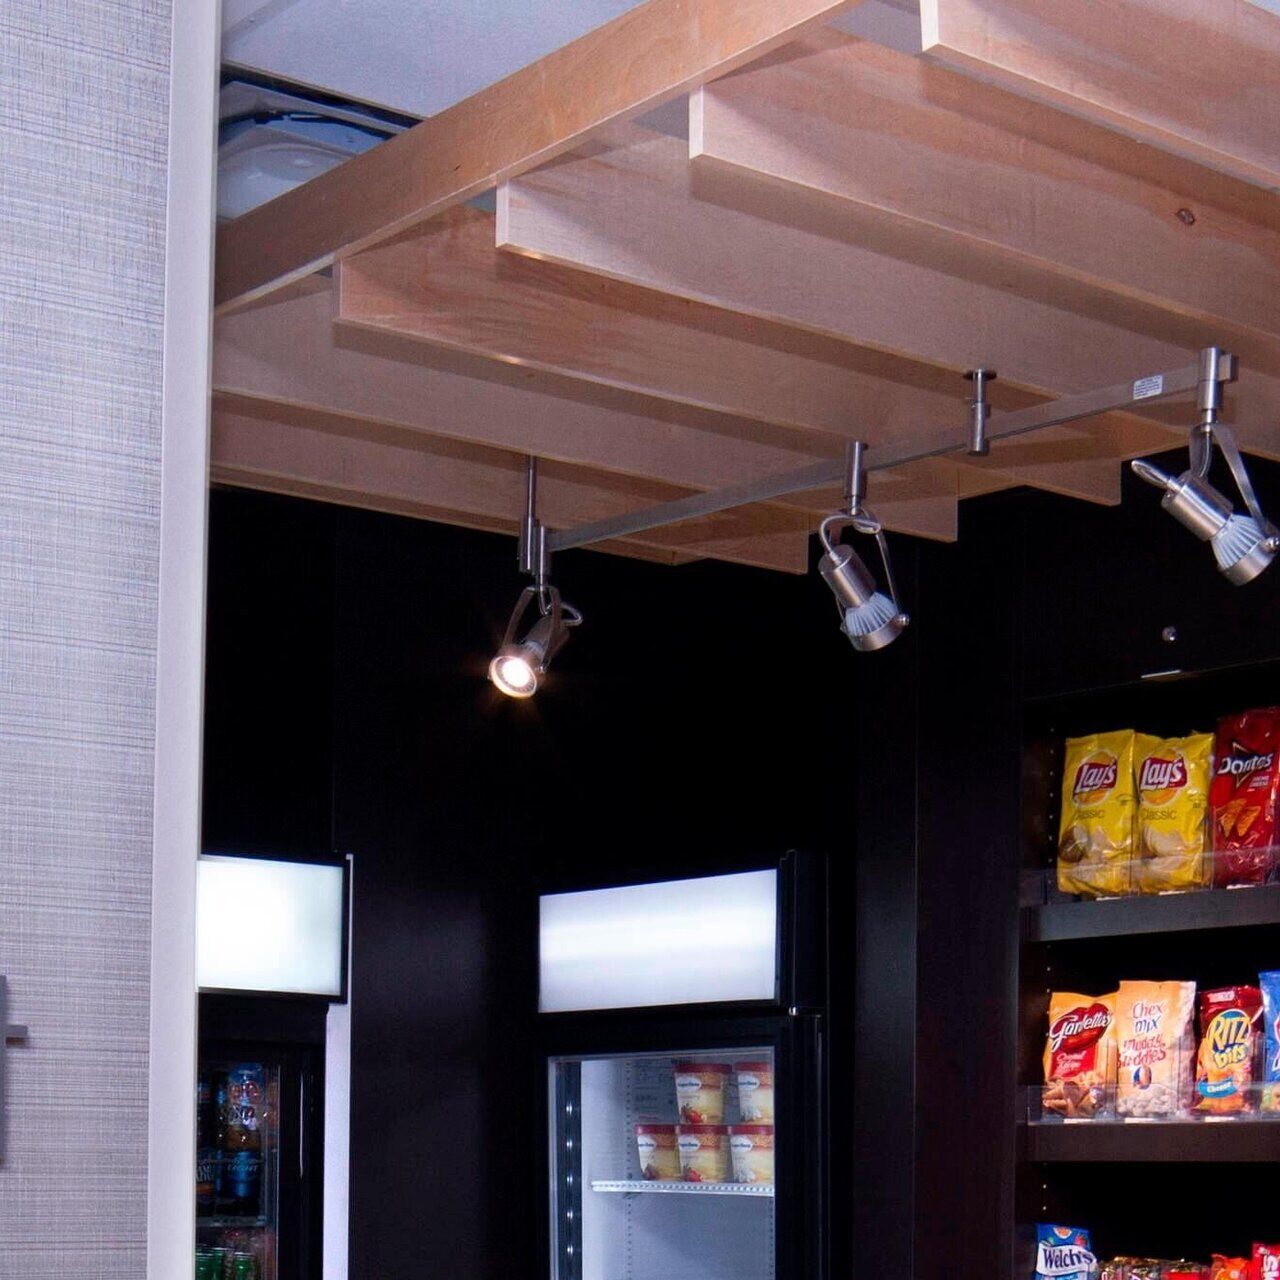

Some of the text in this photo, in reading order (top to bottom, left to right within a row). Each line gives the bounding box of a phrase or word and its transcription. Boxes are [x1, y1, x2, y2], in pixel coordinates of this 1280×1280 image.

[1074, 758, 1117, 795] Lay's
[1140, 756, 1184, 791] Lay's
[1217, 752, 1274, 775] Doritos
[1132, 1002, 1165, 1019] Chex
[1208, 1015, 1251, 1051] RITZ
[1042, 1248, 1094, 1269] Welch's
